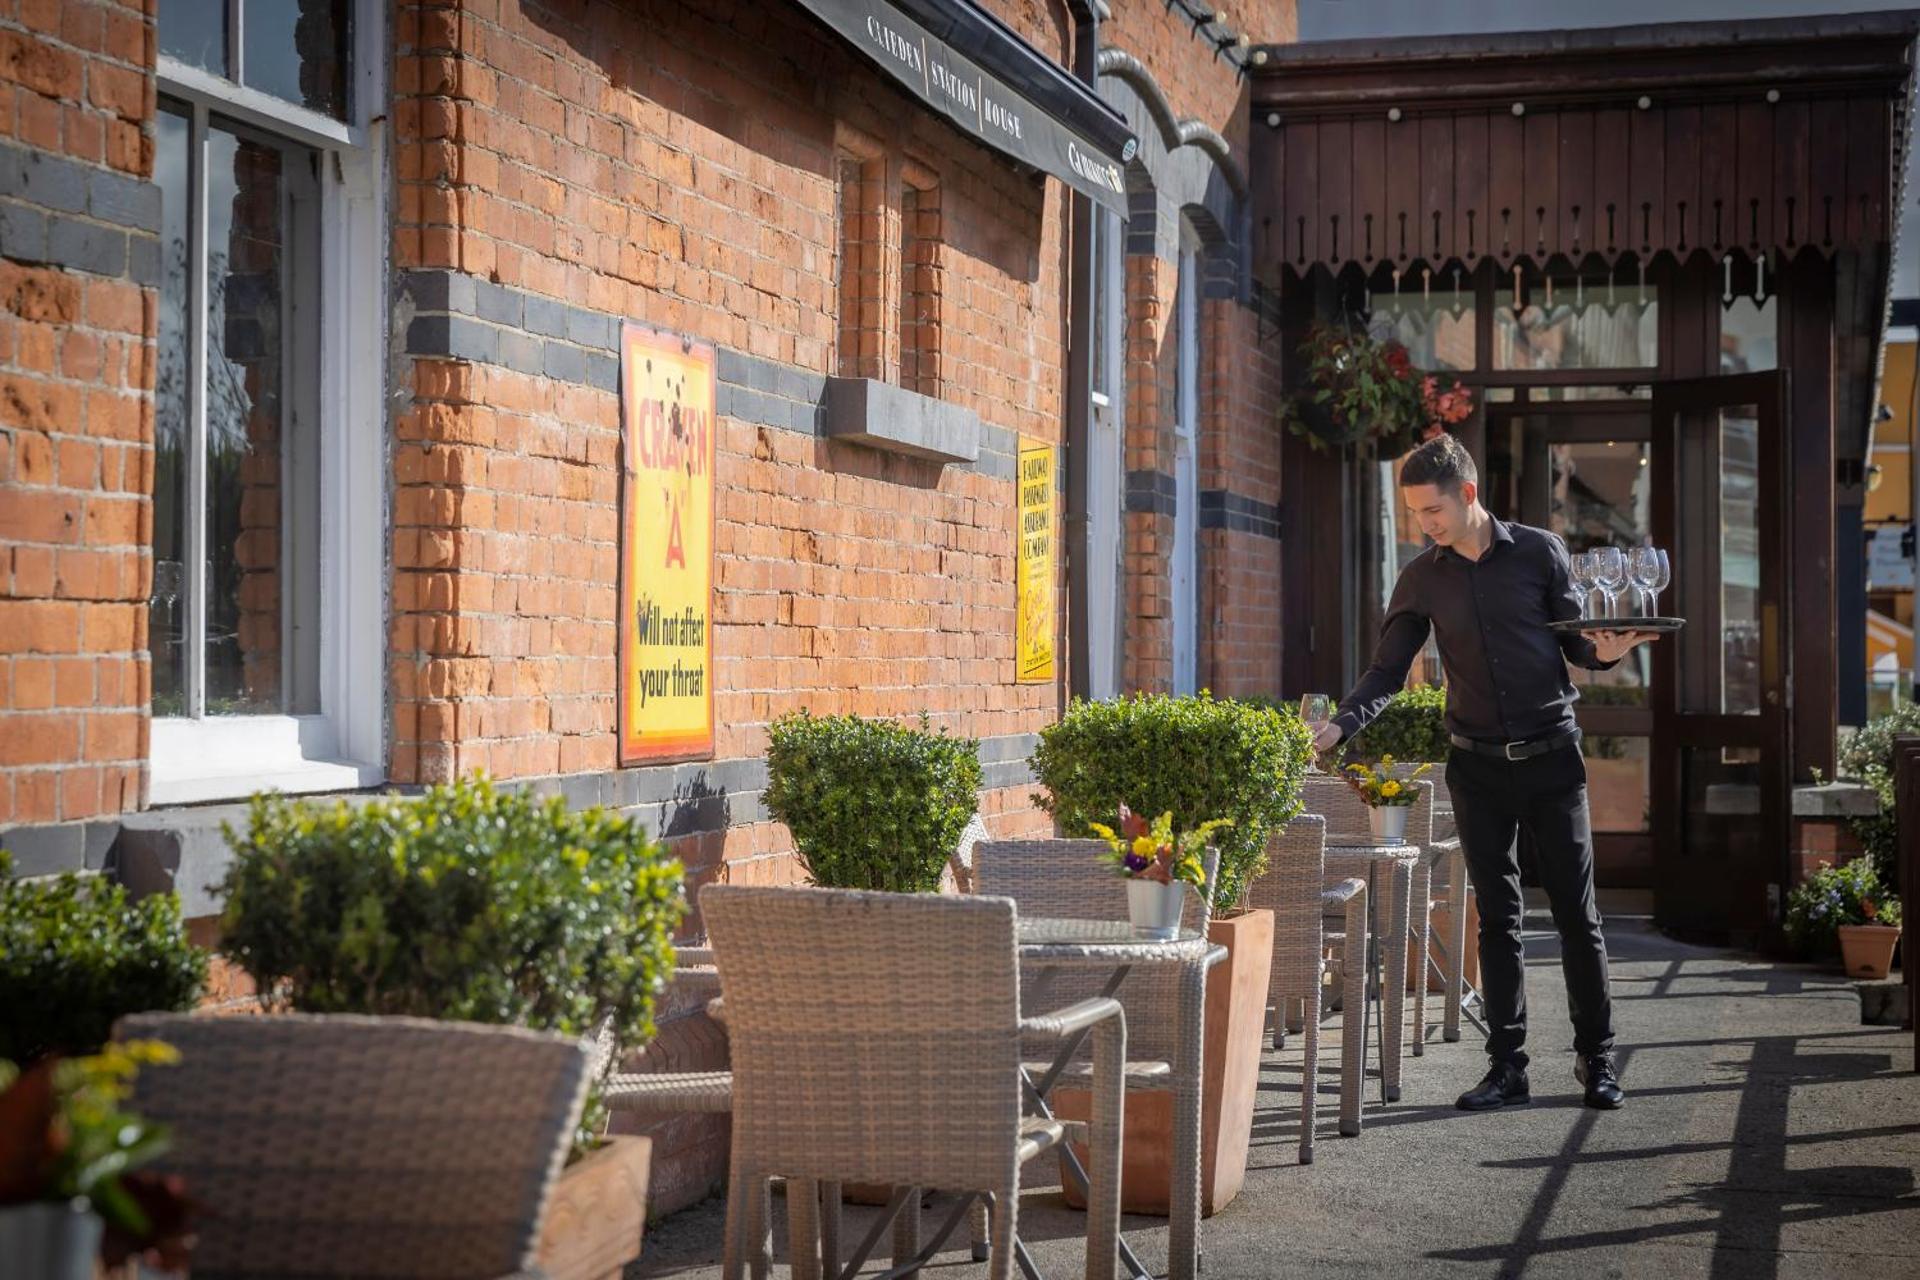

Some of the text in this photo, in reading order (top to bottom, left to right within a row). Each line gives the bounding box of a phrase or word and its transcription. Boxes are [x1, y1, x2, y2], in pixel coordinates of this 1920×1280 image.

[931, 60, 977, 112] STATION
[985, 97, 1023, 140] HOUSE
[637, 599, 704, 647] Will not affect
[639, 658, 702, 708] your throat
